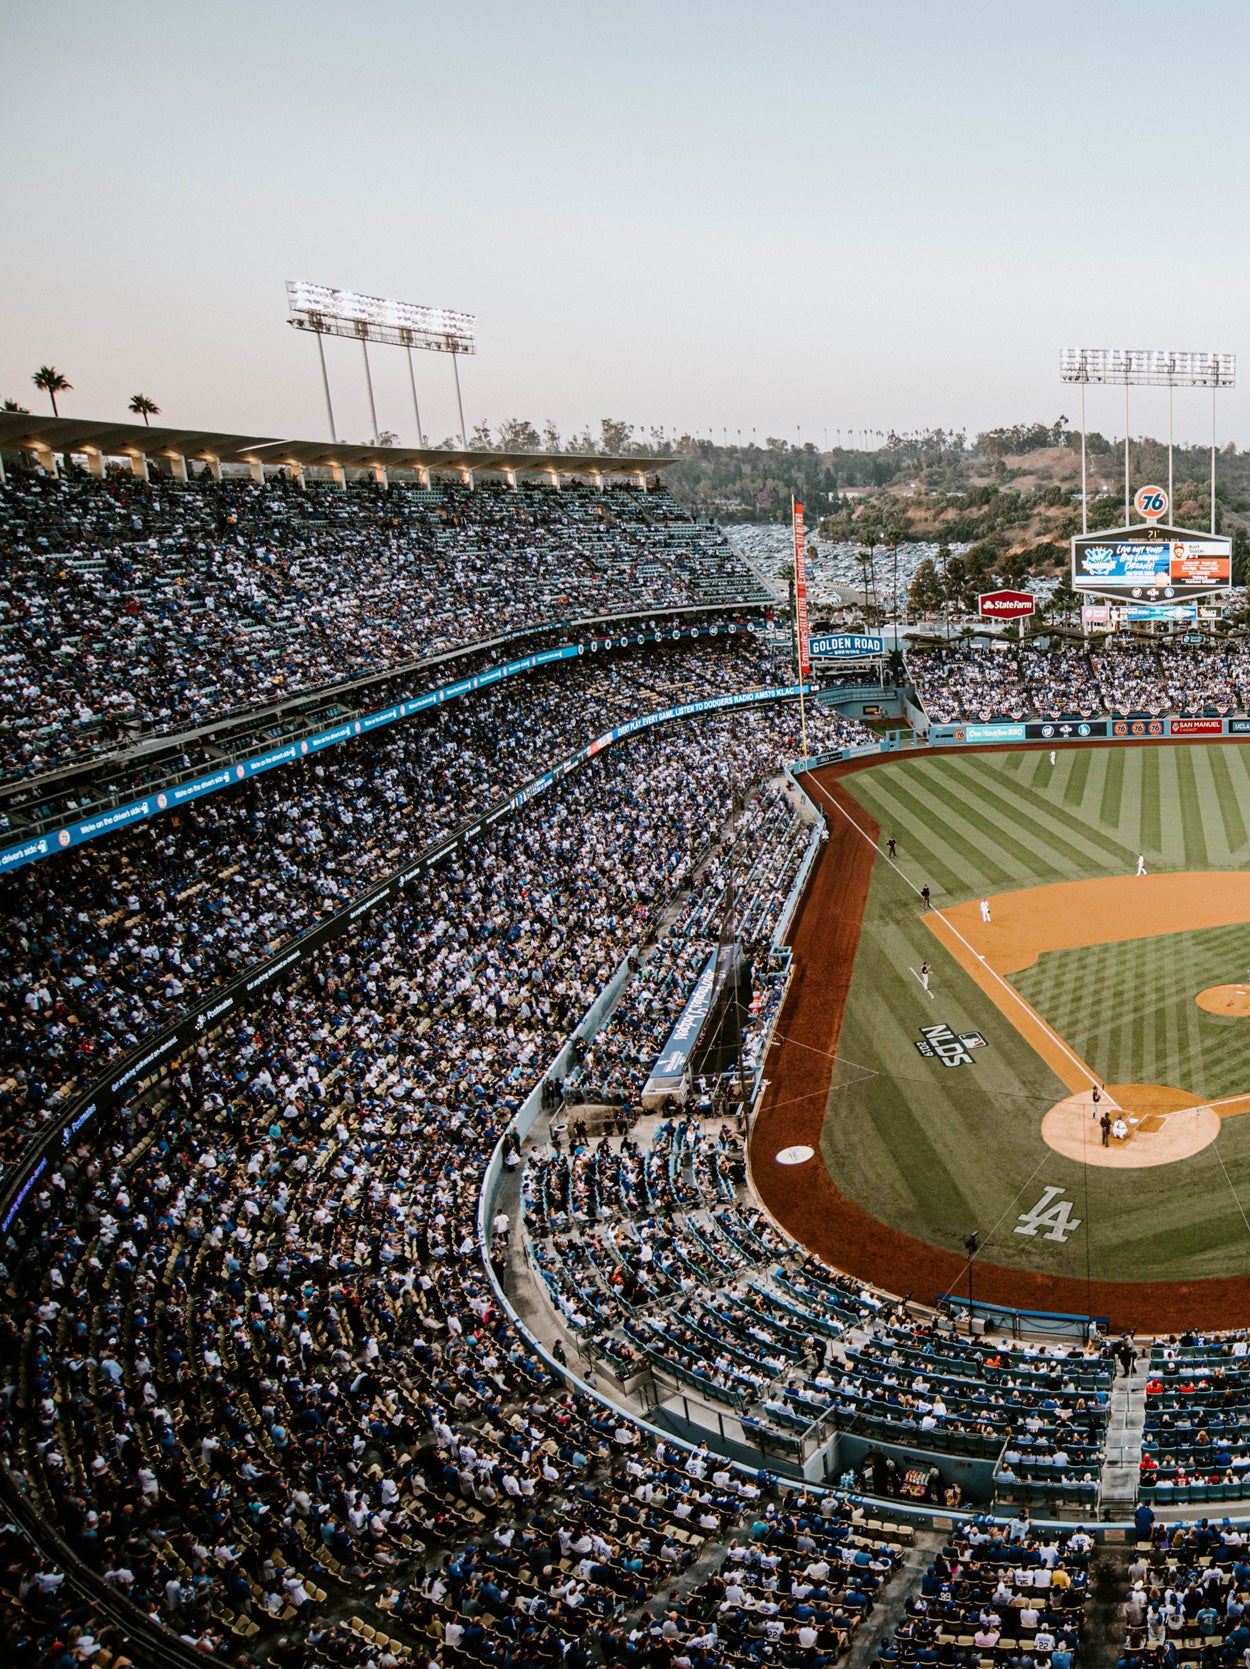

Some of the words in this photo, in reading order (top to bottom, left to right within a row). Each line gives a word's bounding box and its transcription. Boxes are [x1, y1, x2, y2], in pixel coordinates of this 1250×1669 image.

[1143, 494, 1164, 510] 76
[994, 601, 1014, 609] State
[801, 629, 810, 667] Emirates
[813, 638, 851, 653] GOLDEN
[855, 638, 880, 650] ROAD
[643, 712, 658, 726] EVERY
[676, 703, 695, 716] LISTEN
[695, 702, 704, 711] TO
[704, 697, 733, 710] DODGERS
[734, 693, 753, 703] RADIO
[755, 690, 775, 699] AM570
[777, 687, 795, 697] KLAC
[916, 1041, 934, 1057] 2019
[921, 1024, 973, 1067] NLDS
[1013, 1185, 1082, 1243] LA
[768, 1630, 777, 1638] 22
[1039, 1641, 1049, 1650] 22
